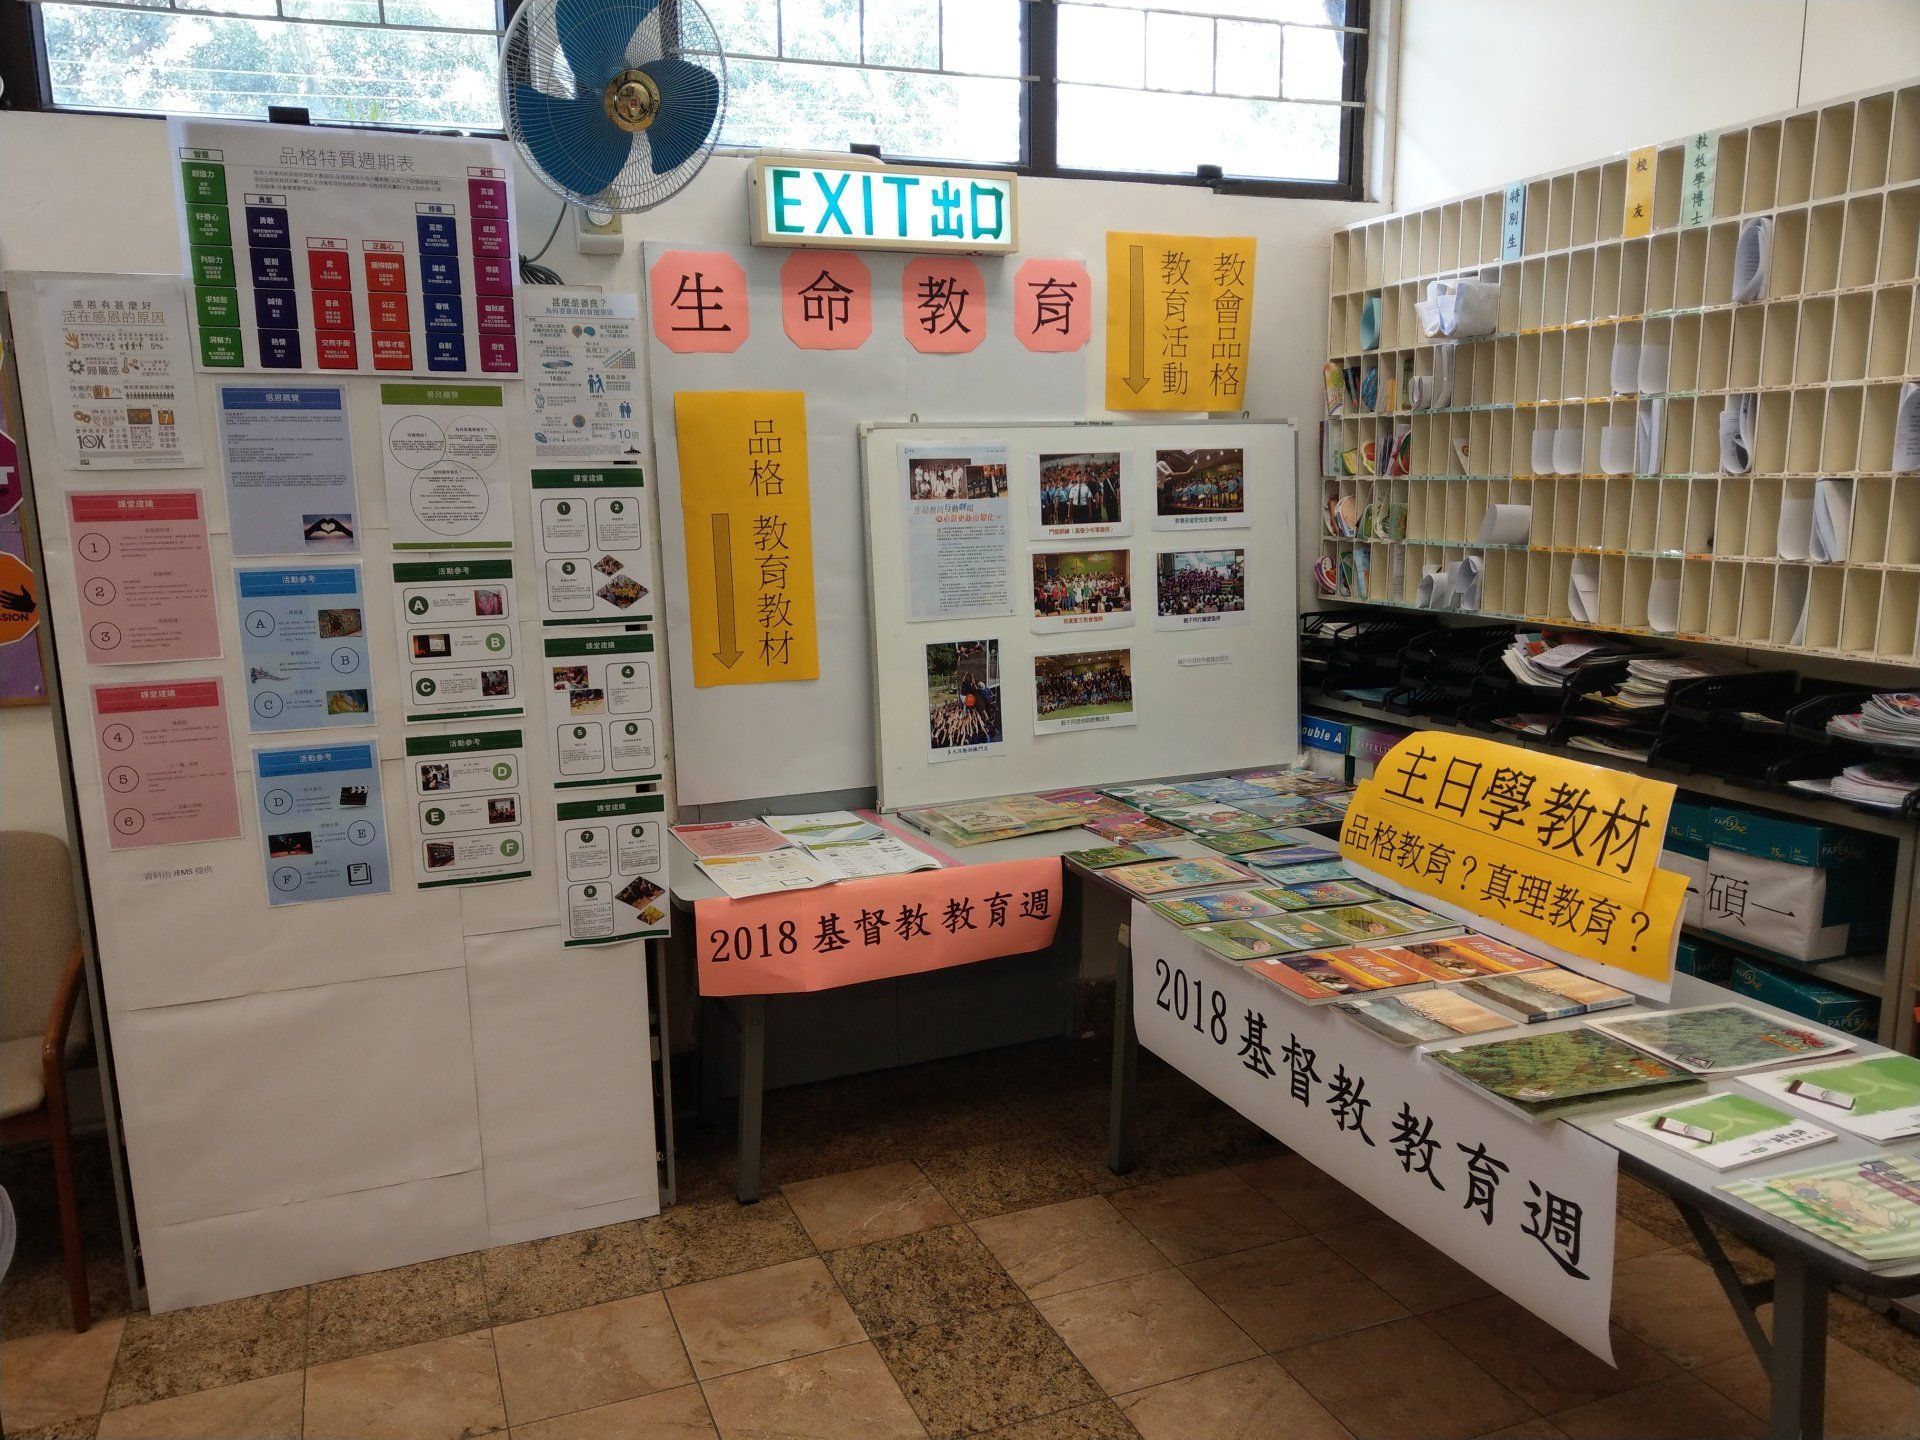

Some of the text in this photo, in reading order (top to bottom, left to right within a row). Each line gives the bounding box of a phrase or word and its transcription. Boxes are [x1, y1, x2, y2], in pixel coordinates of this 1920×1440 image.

[279, 147, 415, 172] 品格特質週期表
[191, 170, 215, 178] 創造力
[1691, 133, 1708, 226] 教牧學博士
[1632, 158, 1648, 219] 校友
[258, 196, 273, 205] 勇氣
[774, 170, 1004, 239] EXIT 出口
[196, 213, 219, 222] 好奇心
[259, 216, 275, 225] 勇敢
[1507, 189, 1520, 250] 特別生
[320, 239, 335, 248] 人性
[200, 255, 223, 264] 判斷力
[263, 258, 279, 266] 堅毅
[326, 260, 333, 268] 愛
[370, 261, 399, 270] 團隊精神
[267, 298, 283, 306] 誠信
[671, 271, 1077, 336] 生命教育
[62, 310, 165, 324] 活在感恩的原因
[1161, 250, 1191, 396] 教育活動
[1211, 252, 1245, 398] 教會品格
[87, 365, 120, 376] 歸屬感
[117, 499, 154, 509] 課堂建議
[90, 543, 99, 553] 1
[749, 419, 794, 666] 品格 教育教材
[438, 566, 470, 575] 活動參考
[282, 575, 316, 584] 活動參考
[95, 587, 105, 598] 2
[413, 600, 424, 611] A
[255, 619, 266, 629] A
[101, 631, 110, 642] 3
[490, 637, 501, 648] B
[340, 656, 350, 665] B
[420, 682, 431, 692] C
[264, 699, 273, 710] C
[113, 732, 122, 743] 4
[1333, 732, 1342, 744] A
[497, 767, 508, 776] D
[119, 774, 128, 785] 5
[274, 798, 284, 807] D
[1384, 746, 1651, 874] 主日學教材
[124, 817, 133, 827] 6
[430, 812, 440, 822] E
[357, 828, 366, 839] E
[505, 843, 514, 853] F
[145, 865, 214, 881] 資料由 JEMS 提供
[282, 875, 291, 884] F
[1706, 873, 1796, 926] 碩一
[710, 921, 798, 962] 2018
[1155, 959, 1228, 1046] 2018
